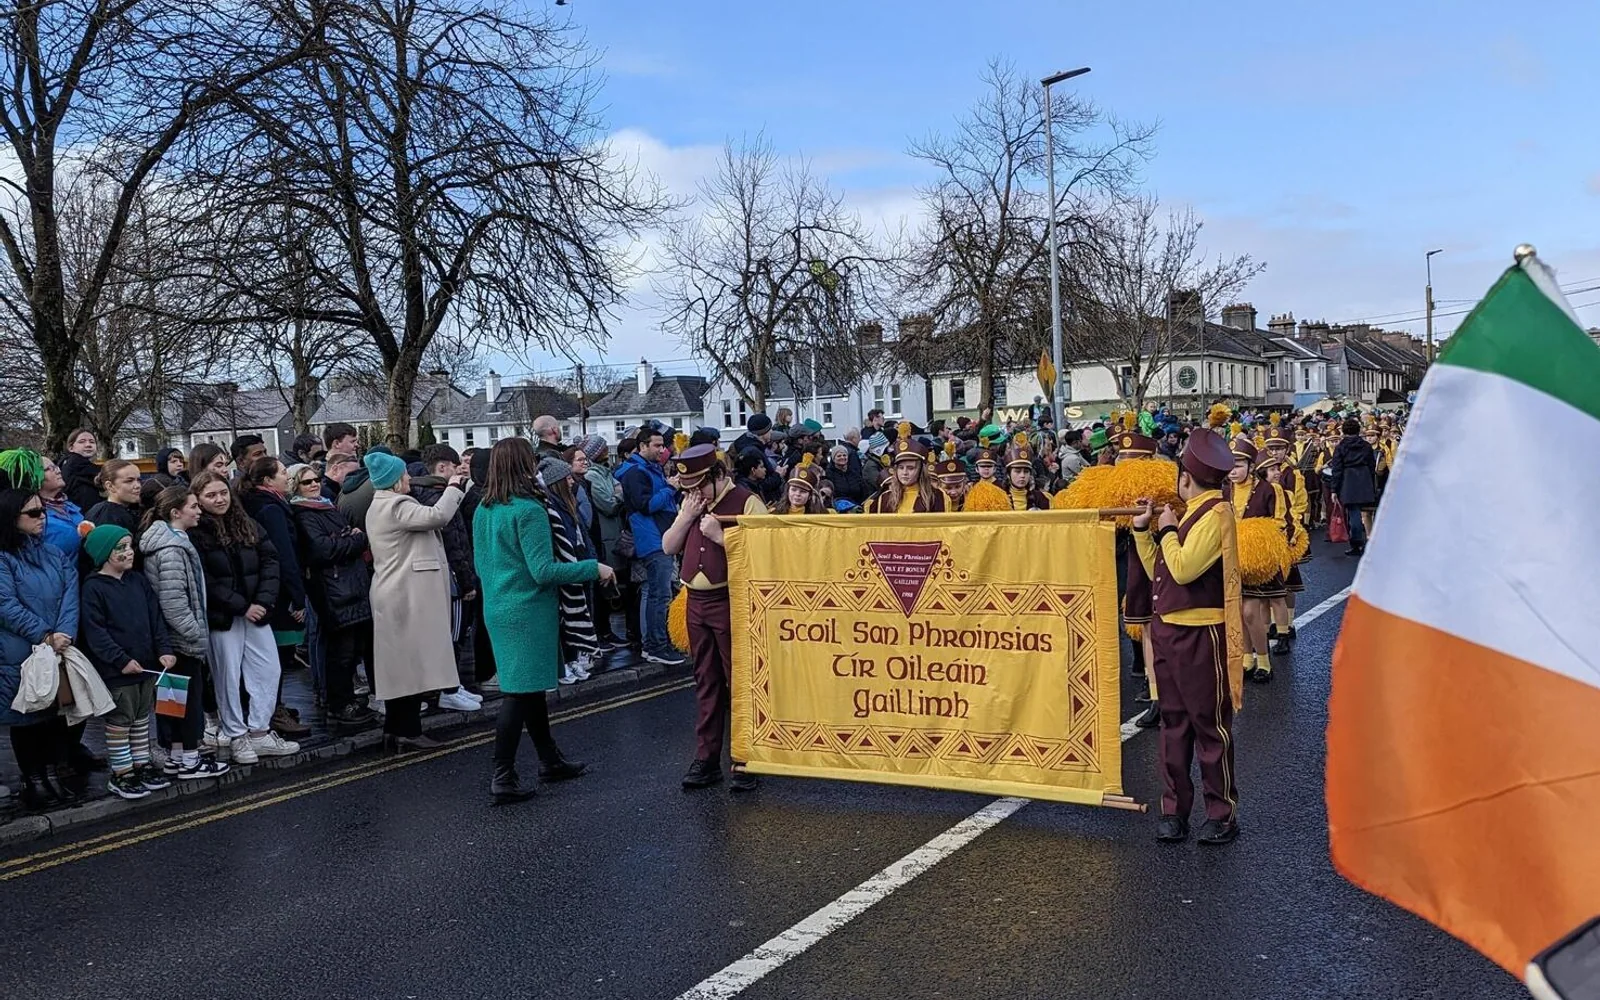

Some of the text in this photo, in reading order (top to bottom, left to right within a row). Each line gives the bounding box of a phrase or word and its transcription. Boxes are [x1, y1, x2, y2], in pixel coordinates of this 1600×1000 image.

[779, 618, 1053, 653] Scoil San Phroinsias
[886, 654, 988, 686] Oileáin
